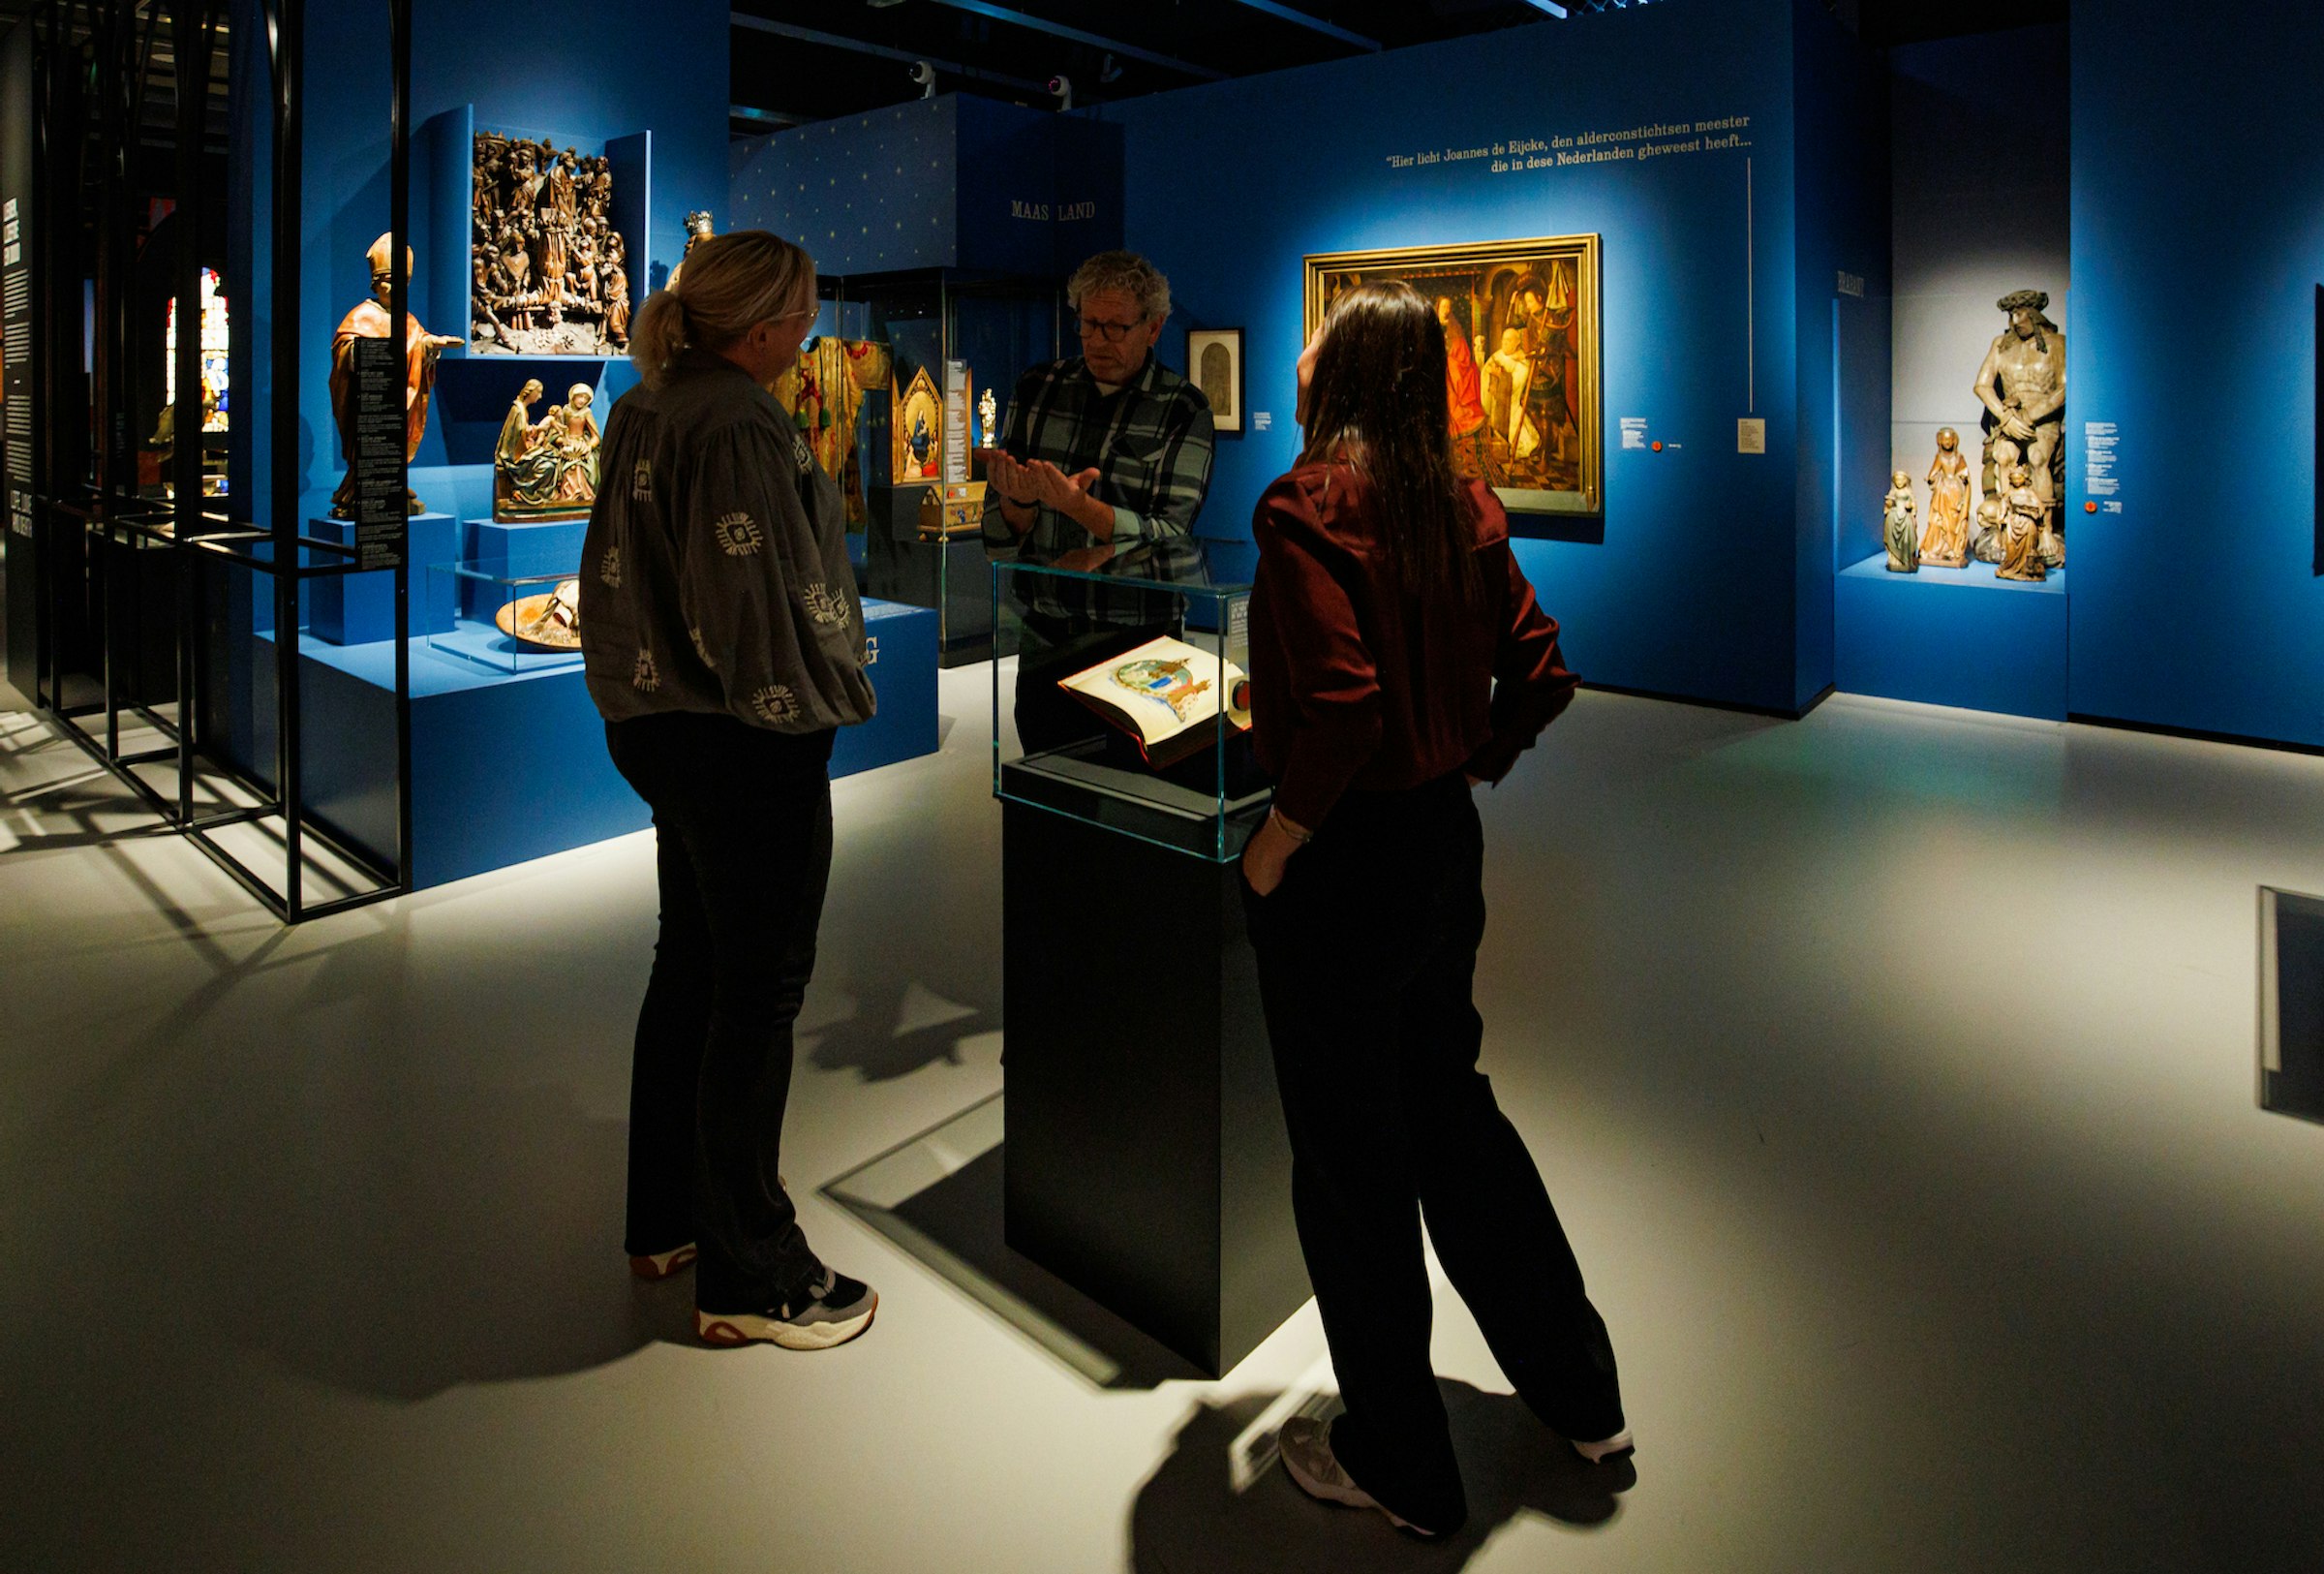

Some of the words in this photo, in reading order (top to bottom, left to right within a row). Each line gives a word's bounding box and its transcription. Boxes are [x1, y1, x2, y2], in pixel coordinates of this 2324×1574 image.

[1417, 151, 1440, 165] licht
[1444, 148, 1488, 162] Joannes
[1491, 142, 1505, 155] de
[1509, 138, 1548, 156] Eijcke,
[1551, 135, 1573, 148] den
[1576, 123, 1690, 145] alderconstichtsen
[1695, 115, 1750, 133] meester
[1490, 160, 1509, 172] die
[1512, 159, 1523, 170] in
[1526, 156, 1553, 169] dese
[1556, 146, 1634, 167] Nederlanden
[1637, 139, 1700, 161] gheweest
[1011, 200, 1050, 222] MAAS
[1056, 201, 1096, 222] LAND
